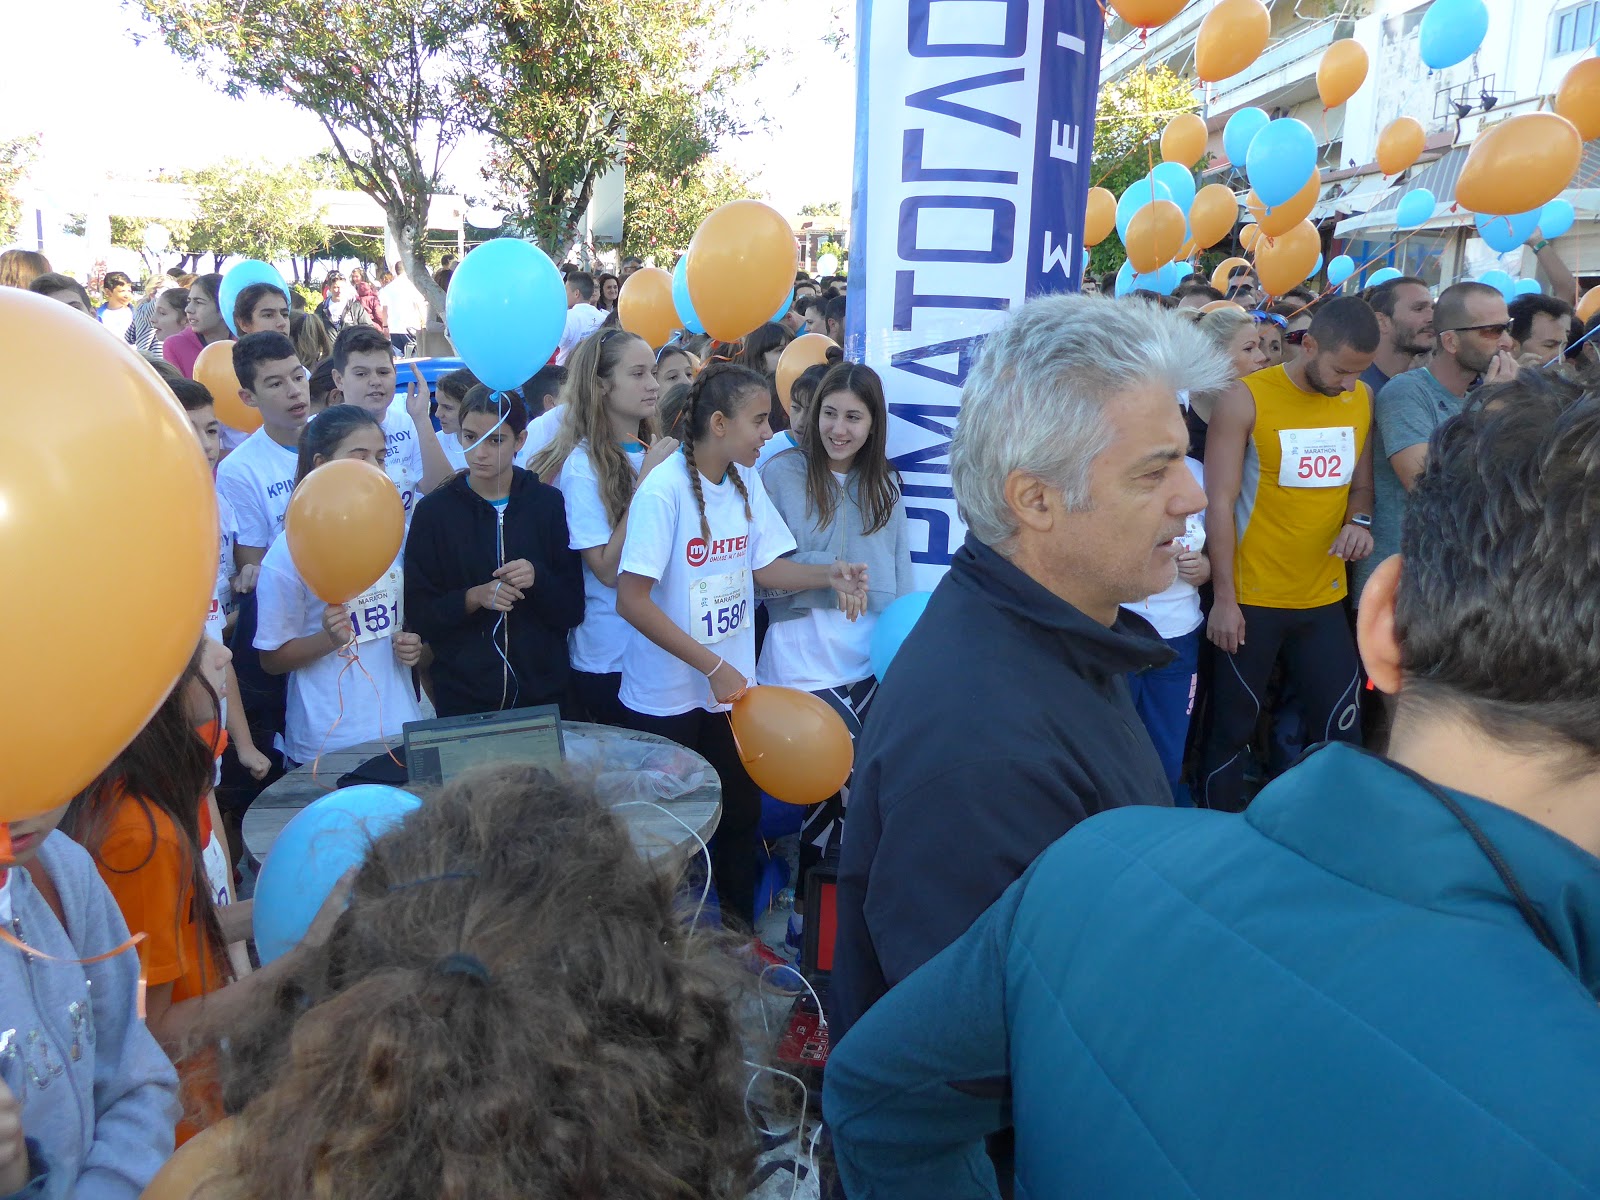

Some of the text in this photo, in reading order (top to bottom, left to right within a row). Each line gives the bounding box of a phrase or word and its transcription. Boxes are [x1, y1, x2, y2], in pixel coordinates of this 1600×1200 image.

[1298, 455, 1341, 479] 502
[350, 600, 398, 637] 1581
[702, 599, 747, 637] 1580
